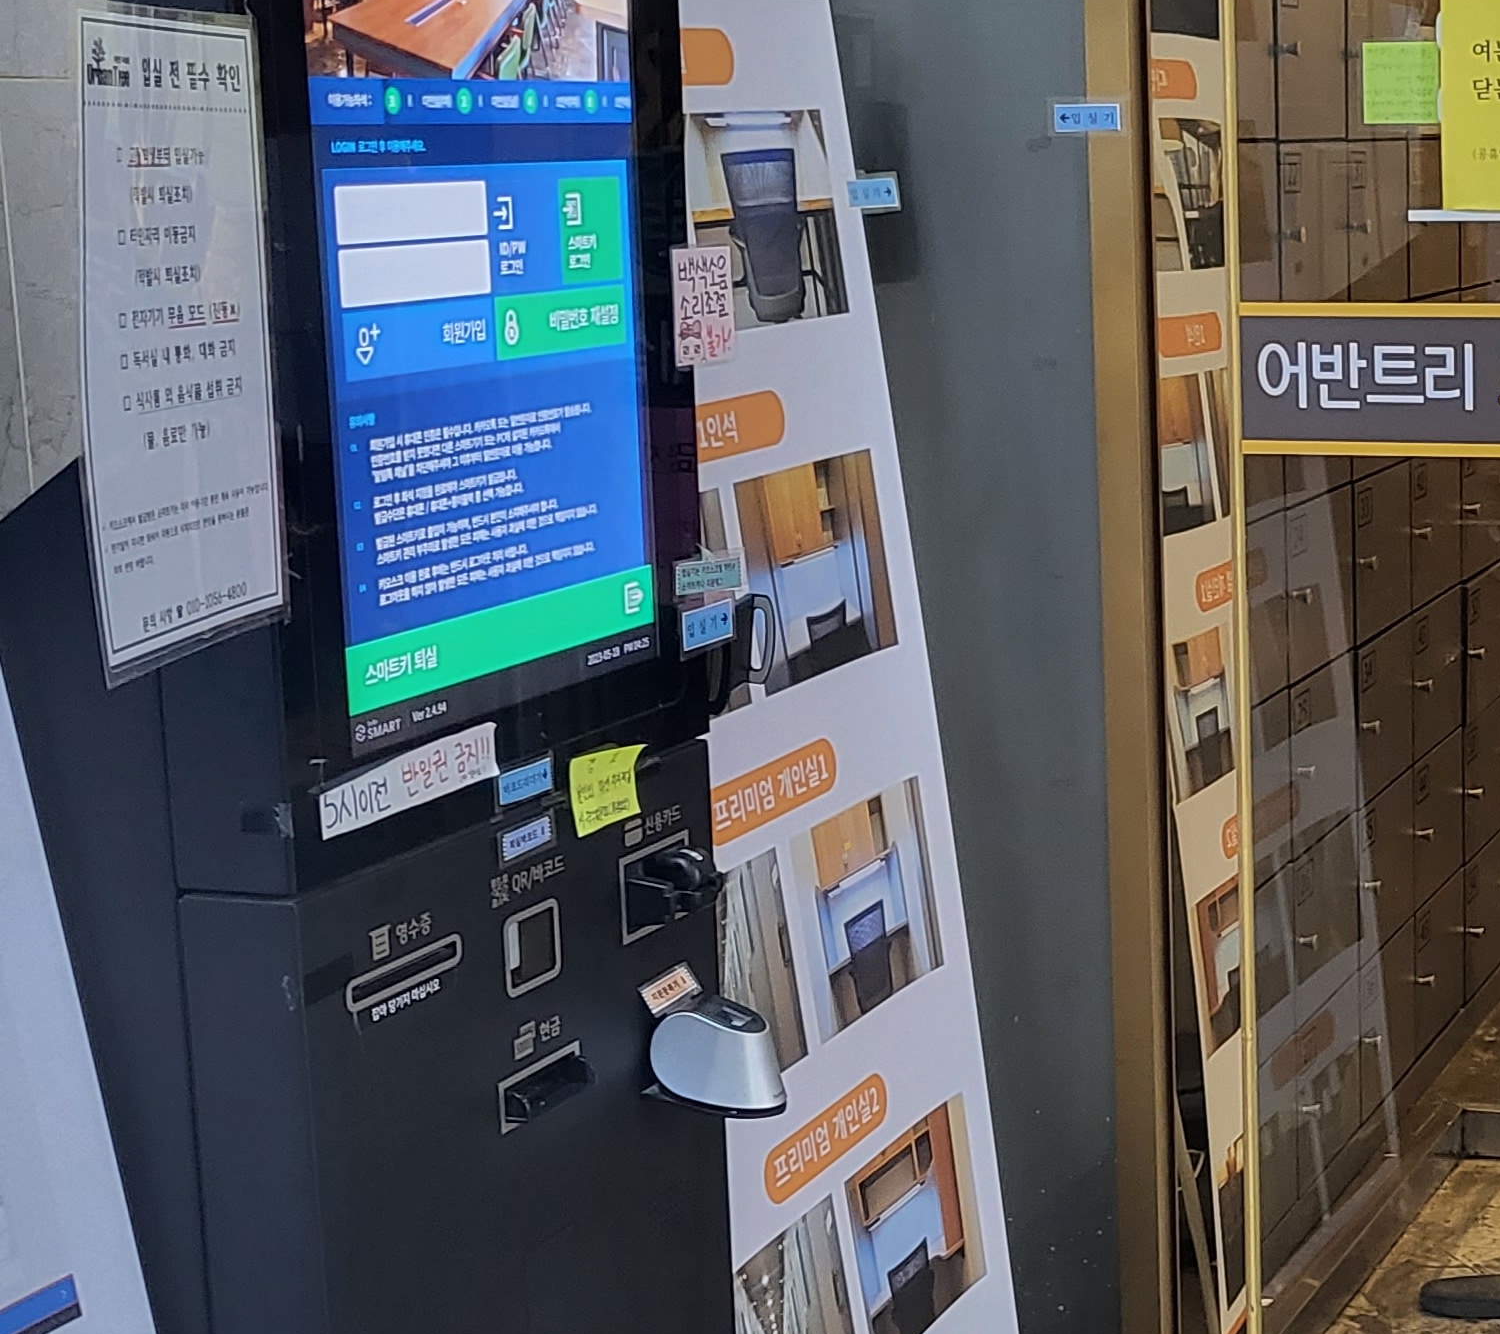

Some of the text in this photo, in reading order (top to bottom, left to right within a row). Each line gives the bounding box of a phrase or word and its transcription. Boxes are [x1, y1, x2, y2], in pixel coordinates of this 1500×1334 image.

[216, 63, 241, 93] 확인
[678, 254, 729, 293] 백색소음
[549, 303, 620, 332] 비밀번호 재설정
[680, 291, 730, 321] 소리조절
[442, 318, 487, 345] 회원가입
[1256, 339, 1475, 414] 어반트리
[364, 644, 438, 686] 스마트키 퇴실
[366, 718, 402, 740] SMART
[324, 776, 392, 829] 5시이전
[713, 753, 830, 832] 프리미엄 개인실1
[644, 804, 682, 836] 신용카드
[511, 854, 566, 896] QR/바코드
[395, 911, 432, 945] 영수증
[539, 1014, 561, 1042] 현금
[773, 1086, 880, 1188] 프리미엄 개인실2
